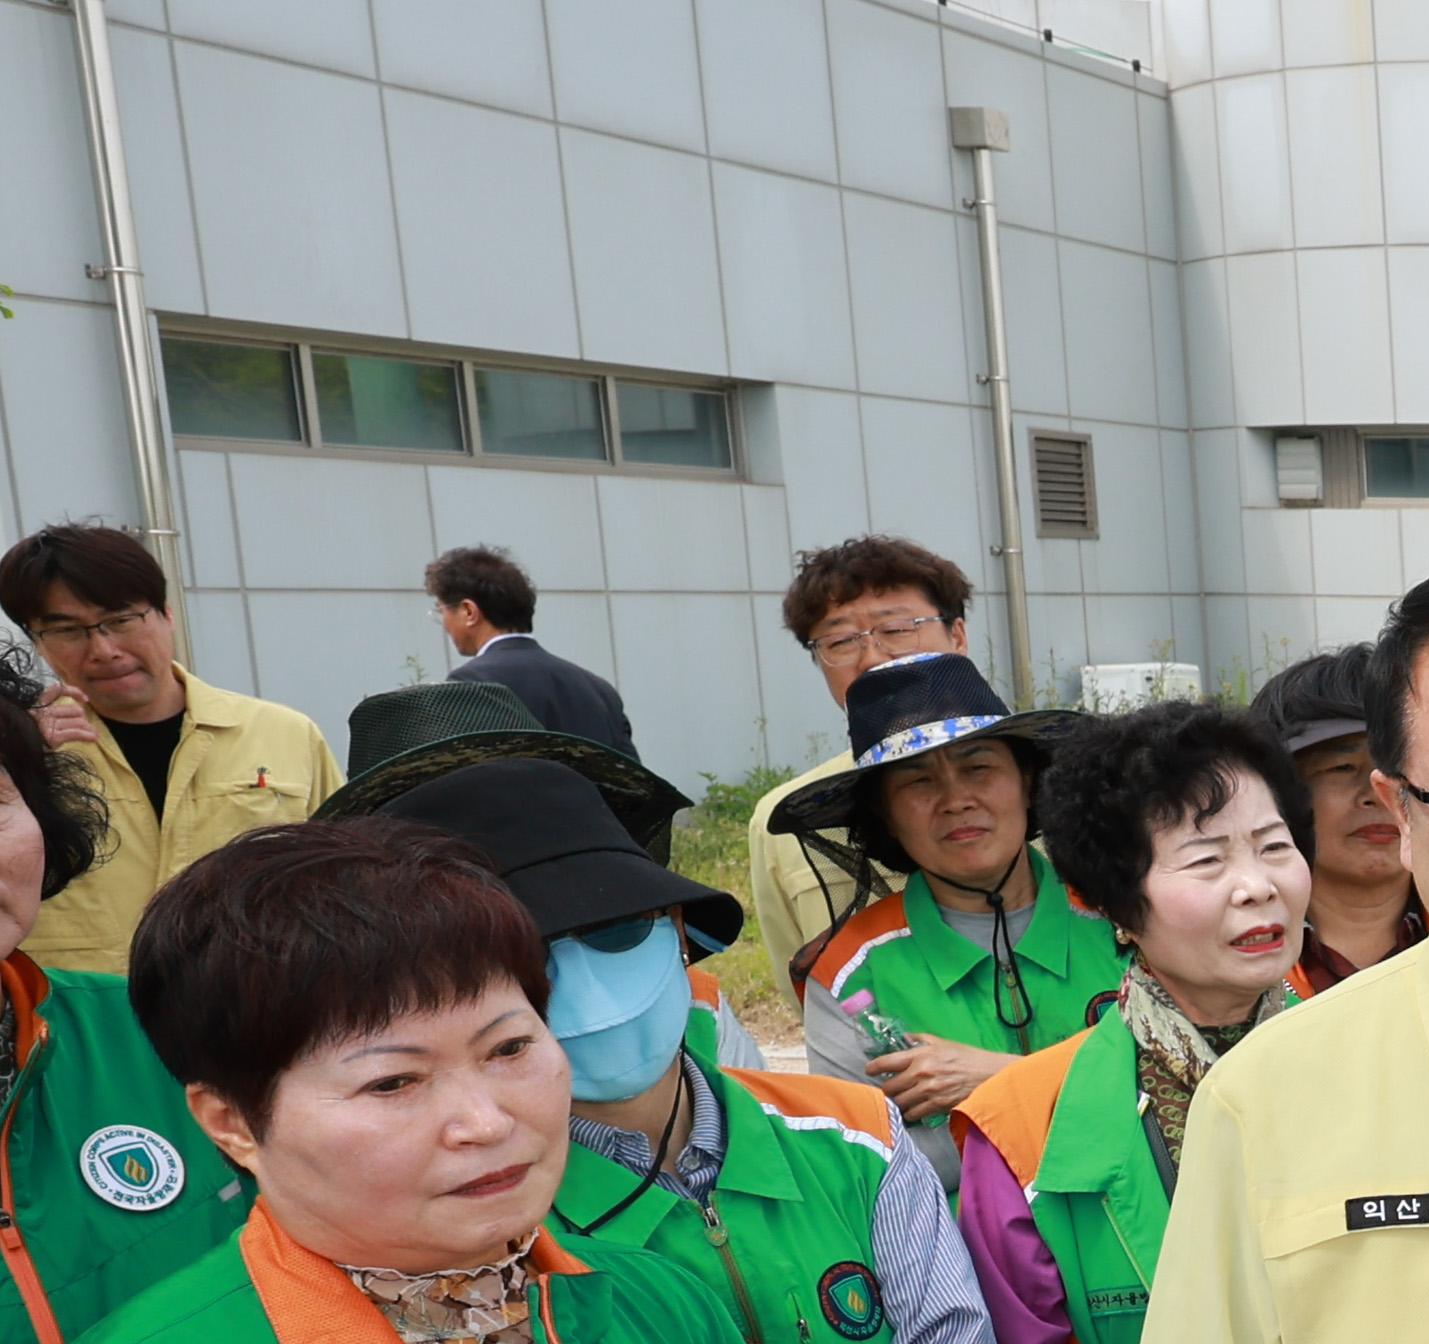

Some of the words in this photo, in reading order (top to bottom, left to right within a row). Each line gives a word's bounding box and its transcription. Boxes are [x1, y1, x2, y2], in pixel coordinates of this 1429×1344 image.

[104, 1130, 134, 1141] ACTIVE
[136, 1132, 146, 1140] IN
[87, 1138, 106, 1160] CORPS
[146, 1136, 177, 1169] DISASTER
[87, 1161, 108, 1190] CITIZEN
